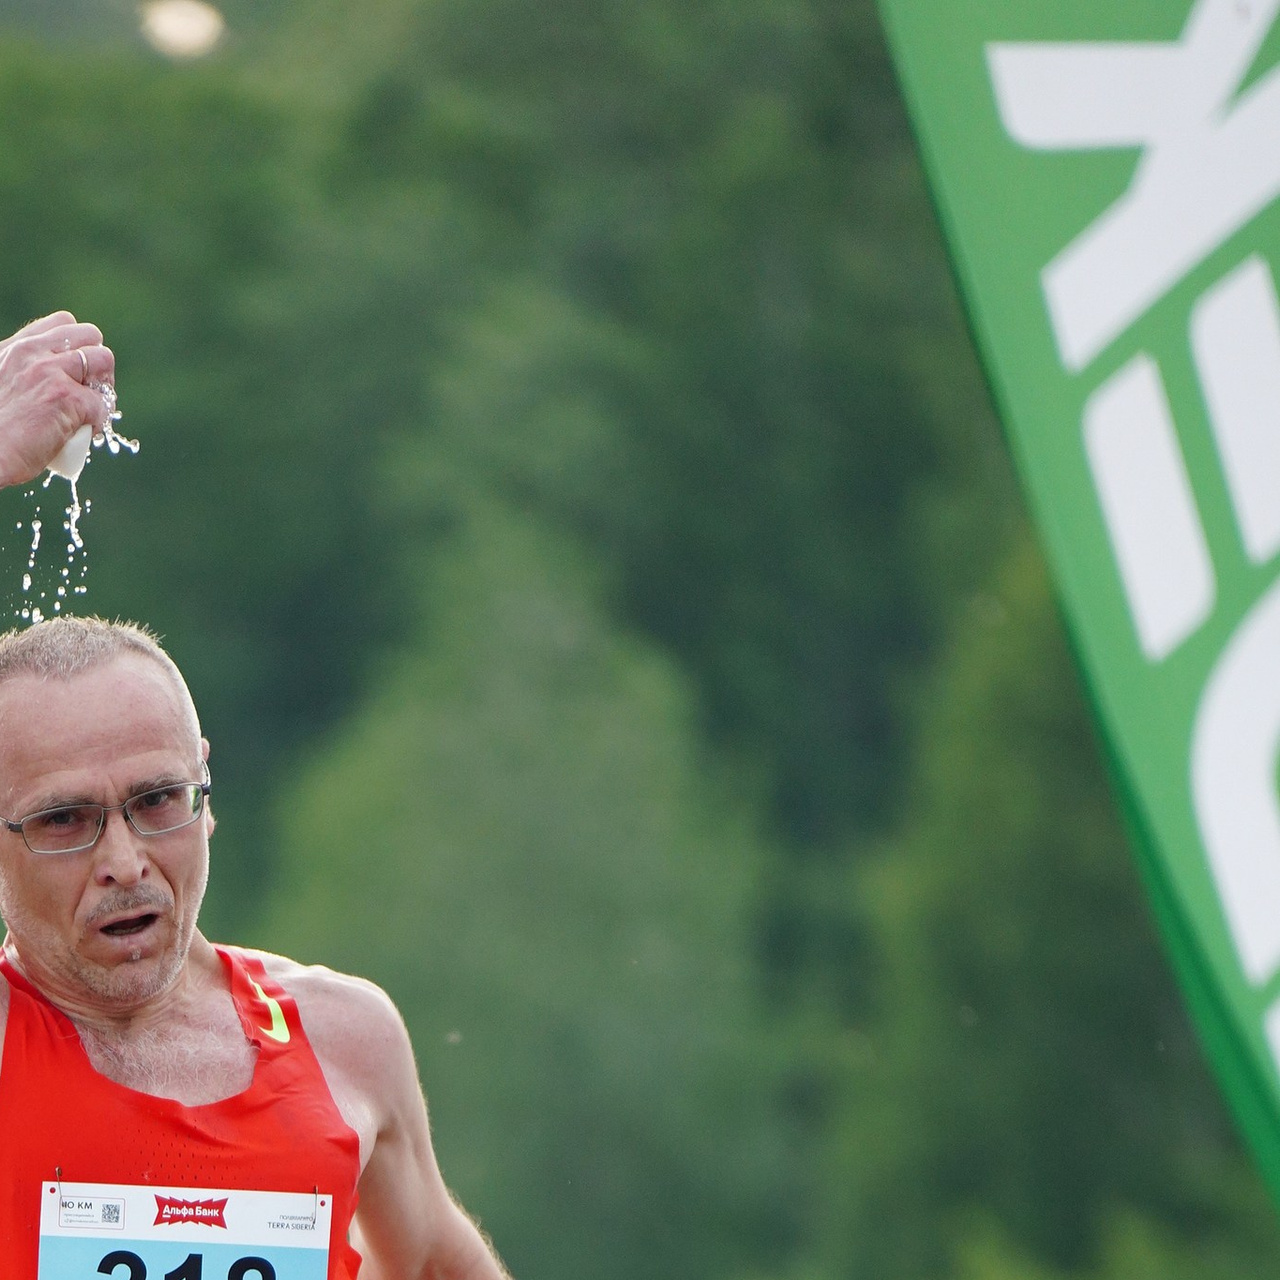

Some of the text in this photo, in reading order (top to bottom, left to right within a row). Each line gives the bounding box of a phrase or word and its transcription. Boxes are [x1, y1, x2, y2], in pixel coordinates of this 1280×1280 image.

[163, 1204, 220, 1218] Альфа Банк
[267, 1221, 291, 1230] TERRA
